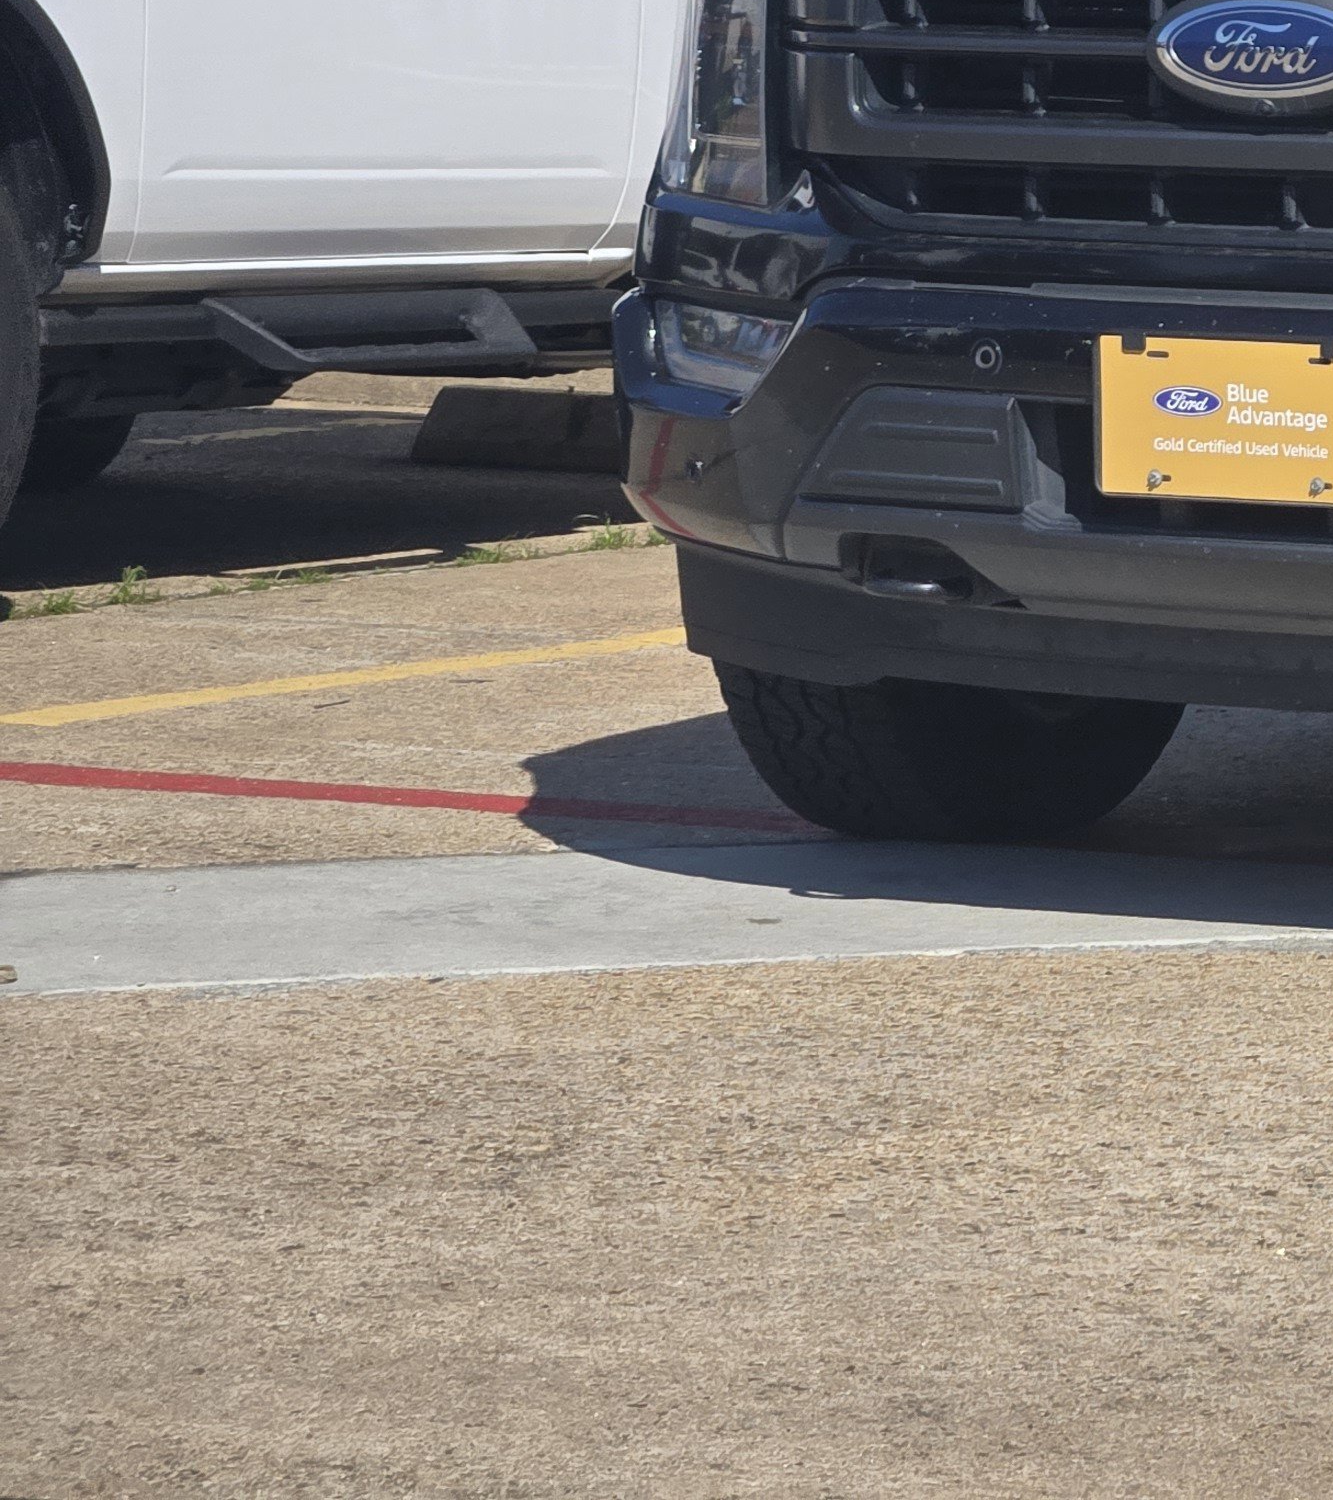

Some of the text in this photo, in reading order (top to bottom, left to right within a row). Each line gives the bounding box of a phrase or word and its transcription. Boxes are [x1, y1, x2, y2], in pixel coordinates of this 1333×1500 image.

[1203, 19, 1320, 74] Ford
[1166, 383, 1268, 412] Ford Blue
[1226, 406, 1328, 432] Advantage
[1153, 437, 1329, 460] Gold Certified Used Vehicle
